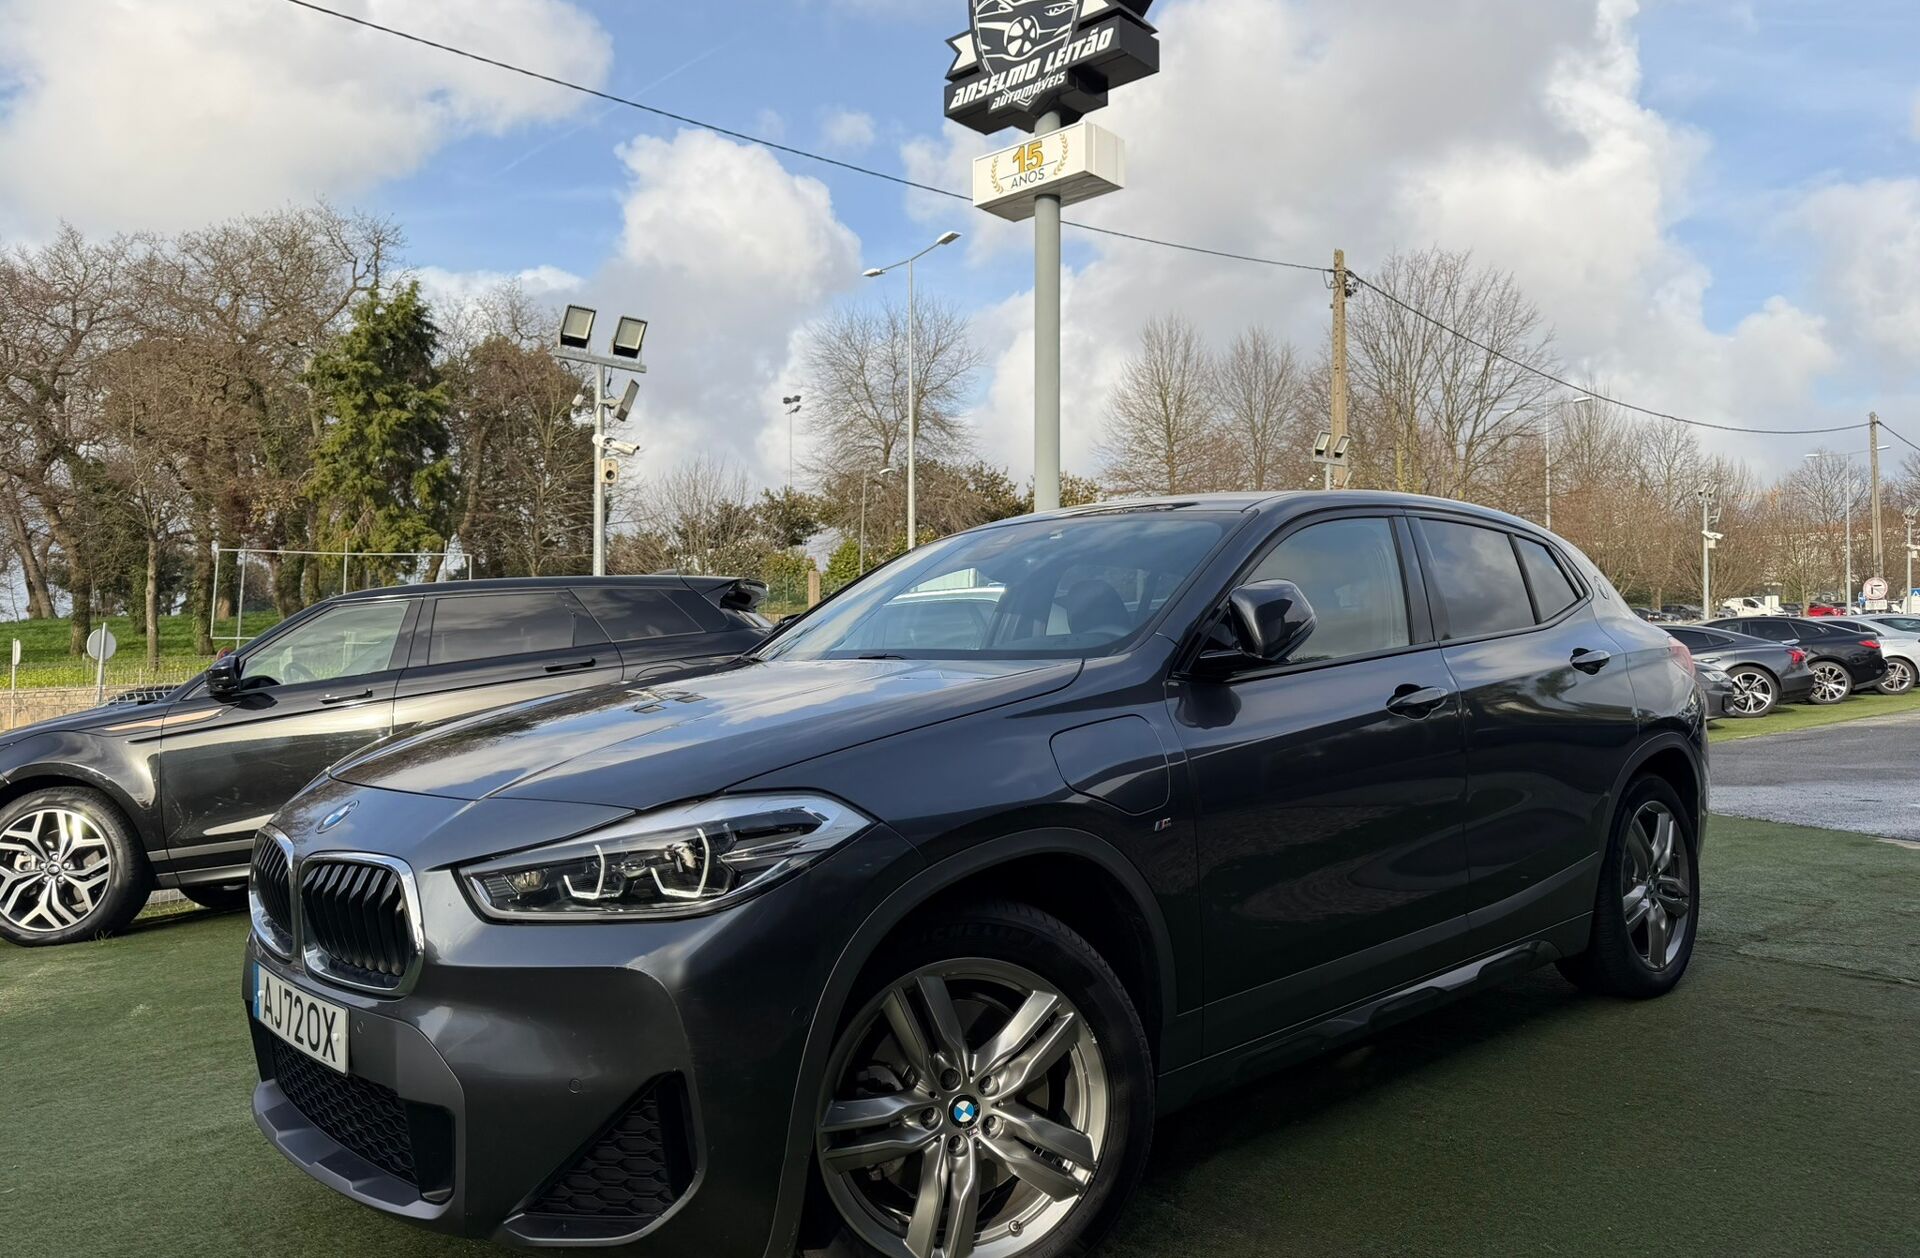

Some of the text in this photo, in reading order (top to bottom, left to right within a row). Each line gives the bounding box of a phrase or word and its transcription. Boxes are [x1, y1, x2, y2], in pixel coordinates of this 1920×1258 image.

[949, 27, 1114, 110] ANSELMO LEITÃO
[990, 71, 1066, 110] AUTOMÓVEIS
[1013, 141, 1044, 173] 15
[1011, 167, 1045, 189] ANOS
